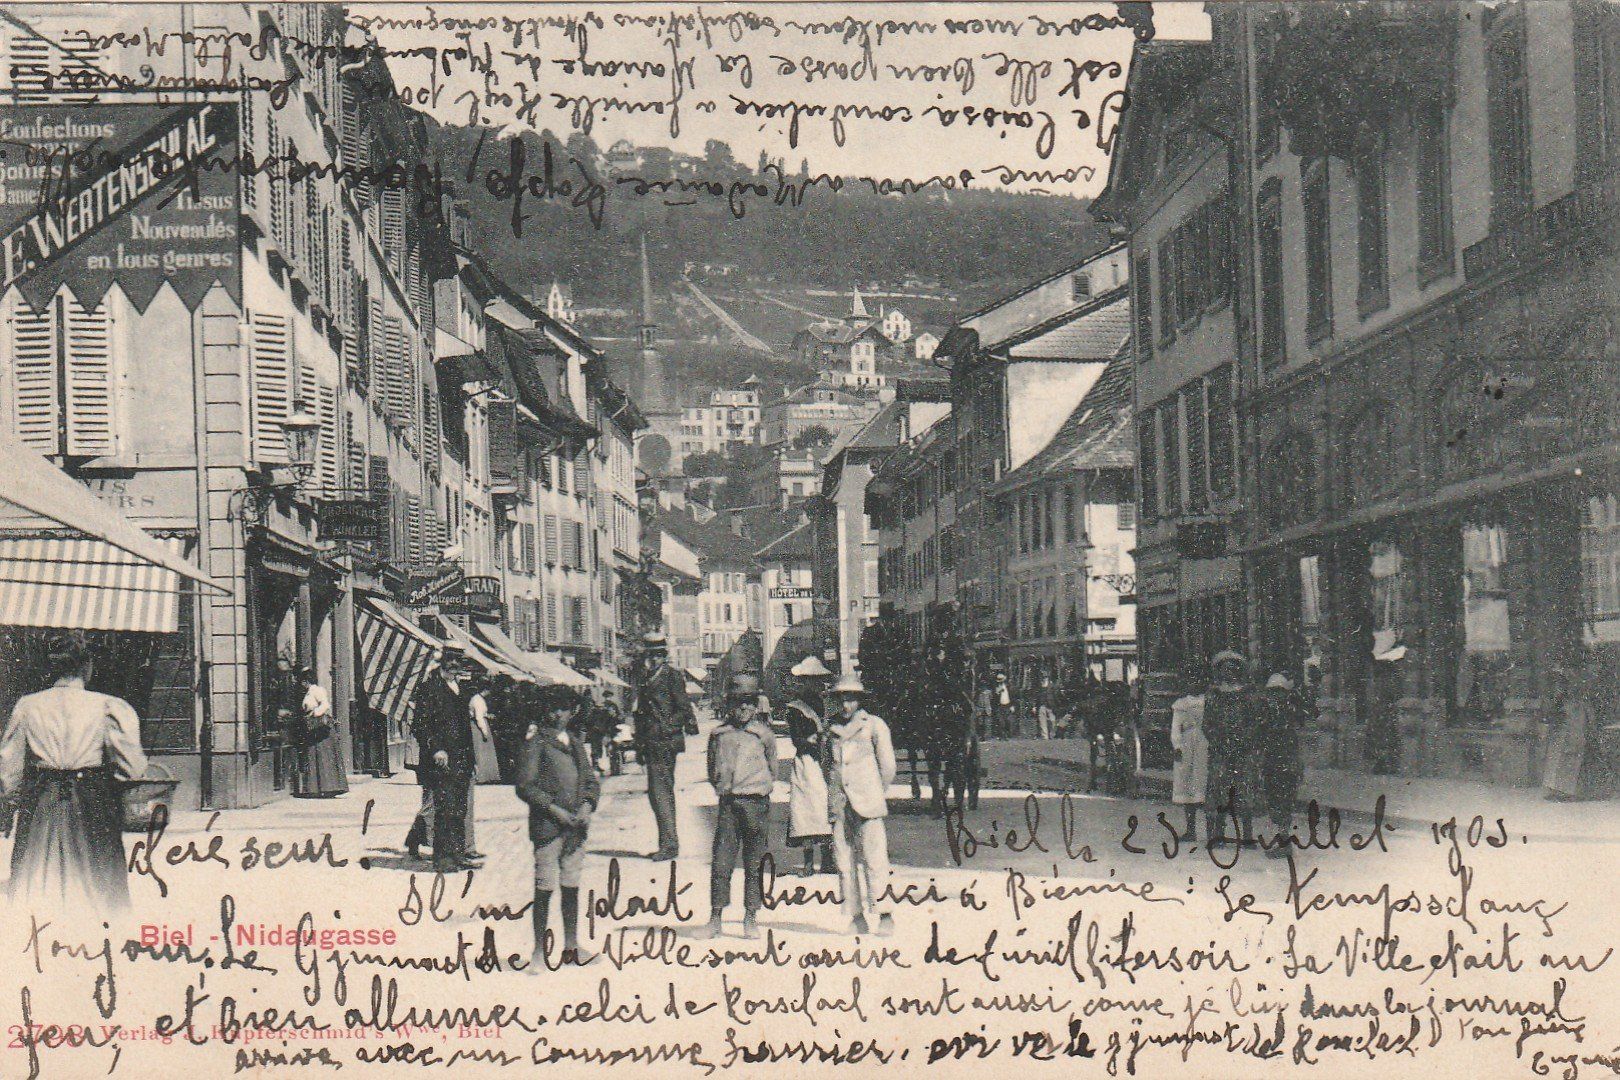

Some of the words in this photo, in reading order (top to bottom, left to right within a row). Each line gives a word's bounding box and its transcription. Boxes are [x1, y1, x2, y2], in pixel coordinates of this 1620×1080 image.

[87, 257, 111, 270] en
[117, 243, 159, 270] tous
[163, 249, 234, 276] genres
[771, 587, 799, 598] HOTEL
